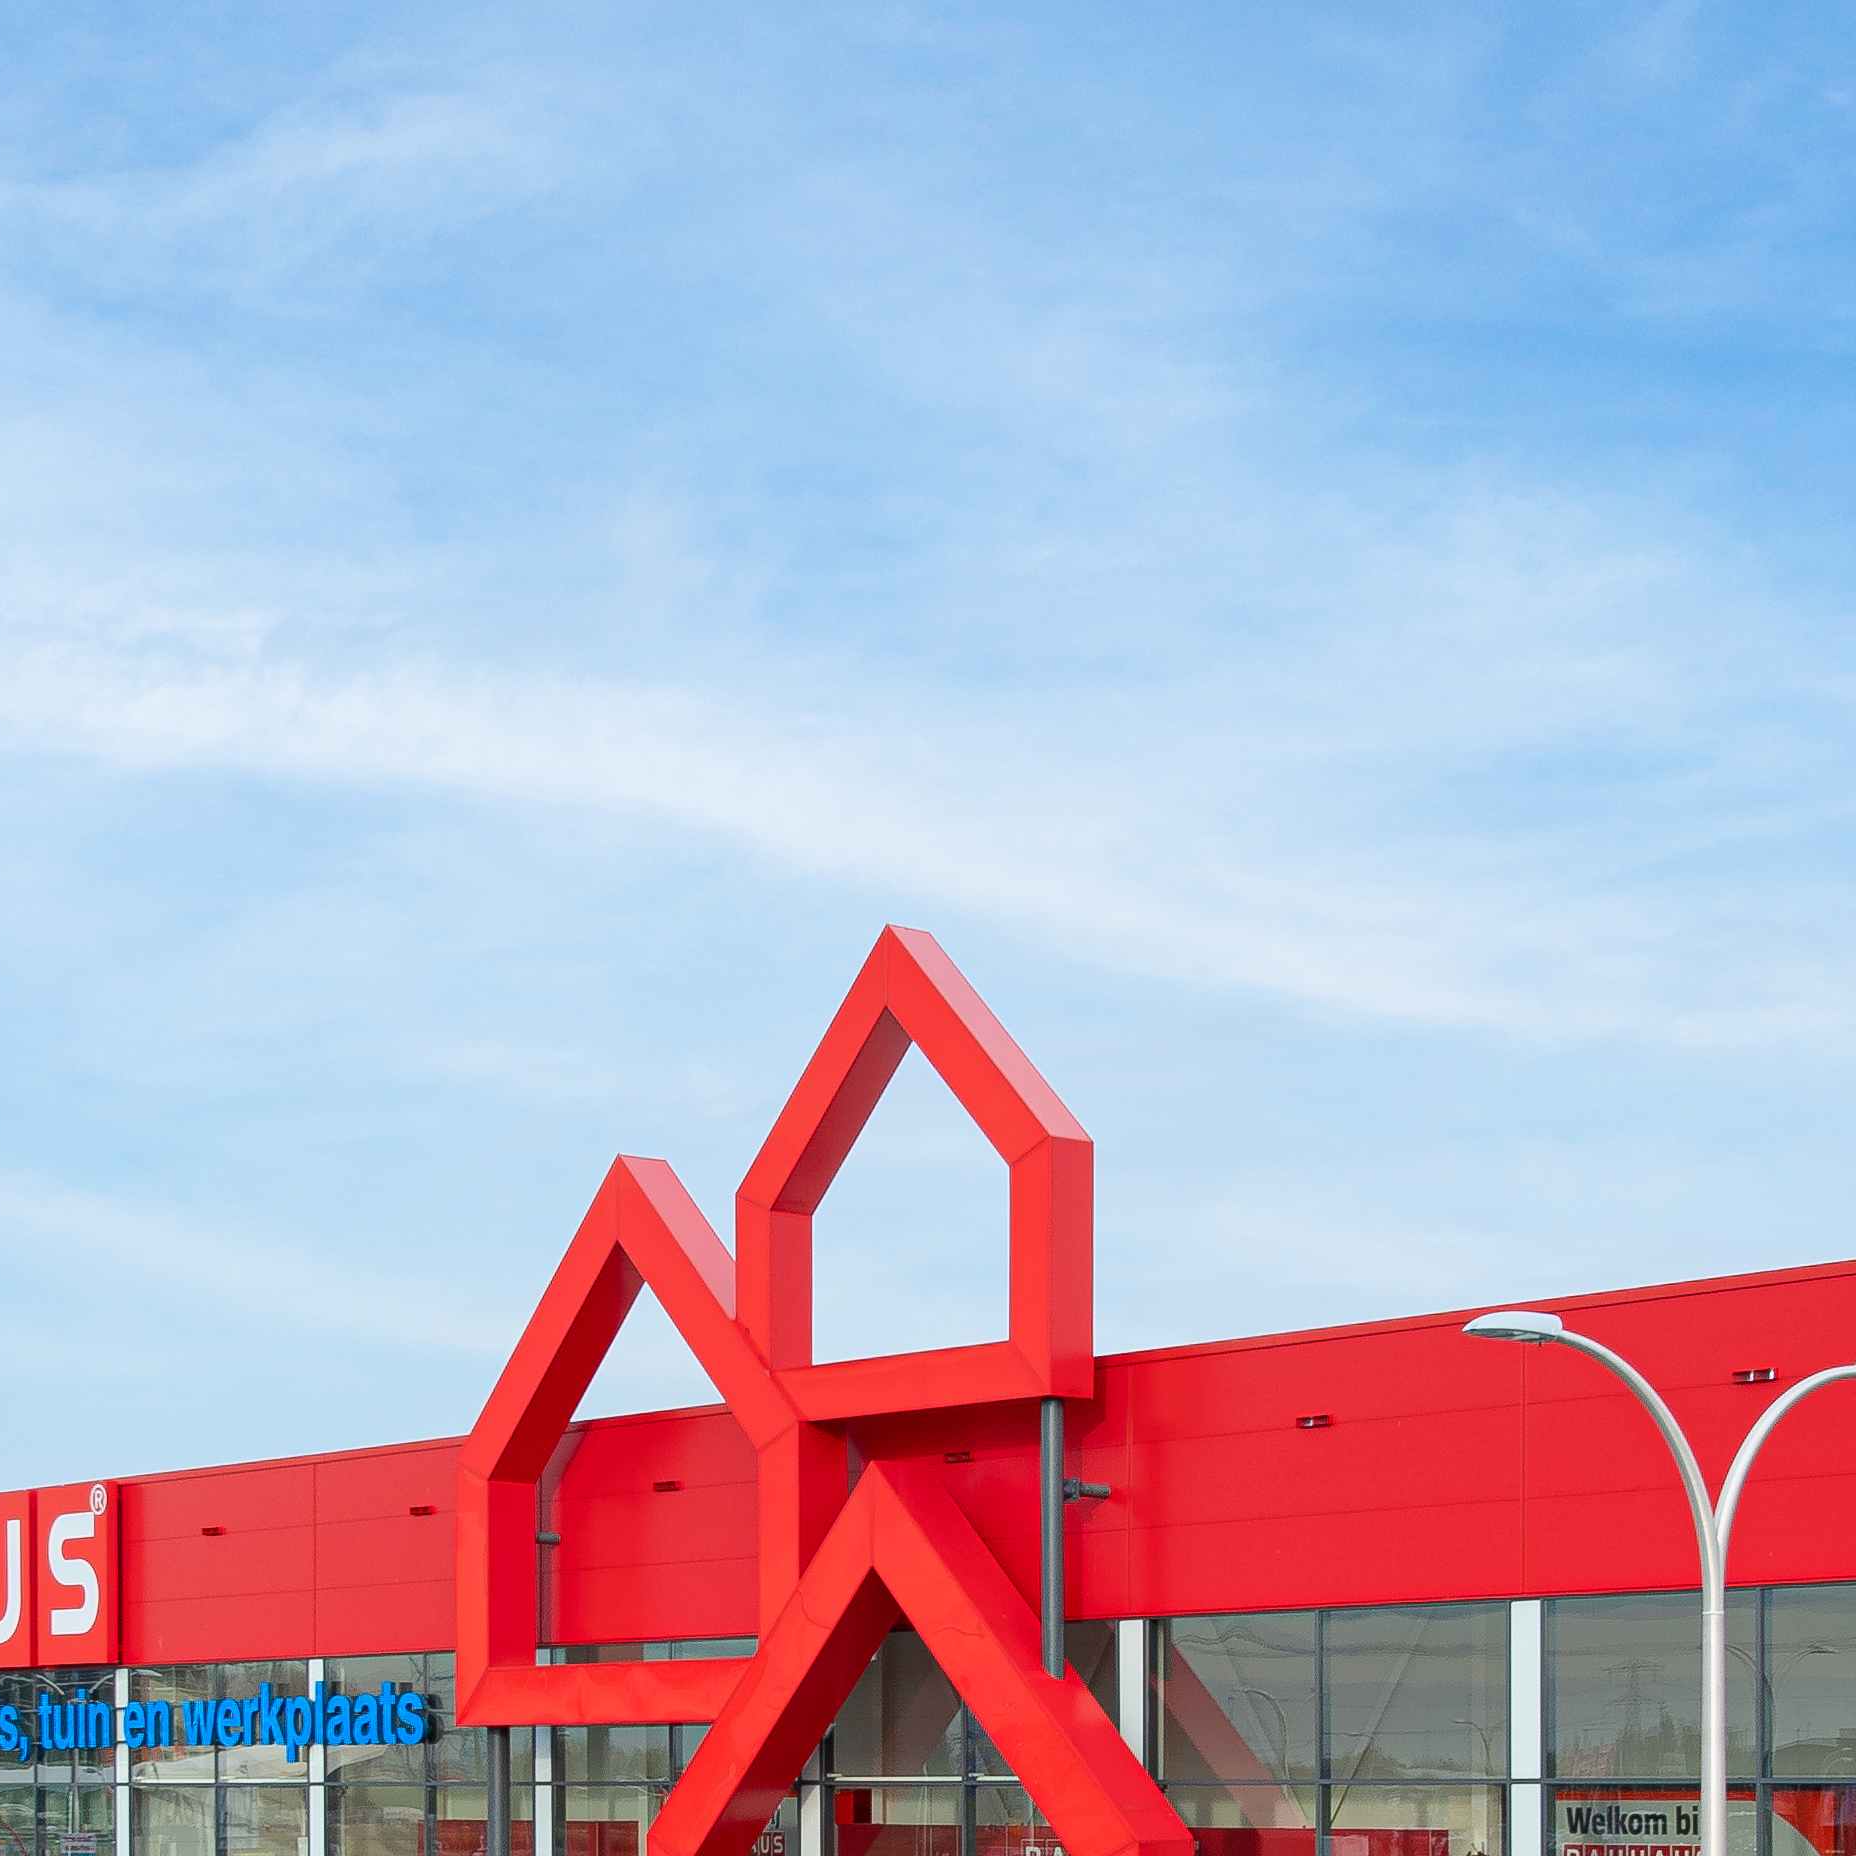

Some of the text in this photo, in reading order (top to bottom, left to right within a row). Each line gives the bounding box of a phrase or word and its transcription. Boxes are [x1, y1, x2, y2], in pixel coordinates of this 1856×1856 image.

[39, 1685, 110, 1749] tuin
[123, 1699, 171, 1747] en
[183, 1681, 428, 1762] werkplaats
[1566, 1806, 1701, 1841] Welkom bi
